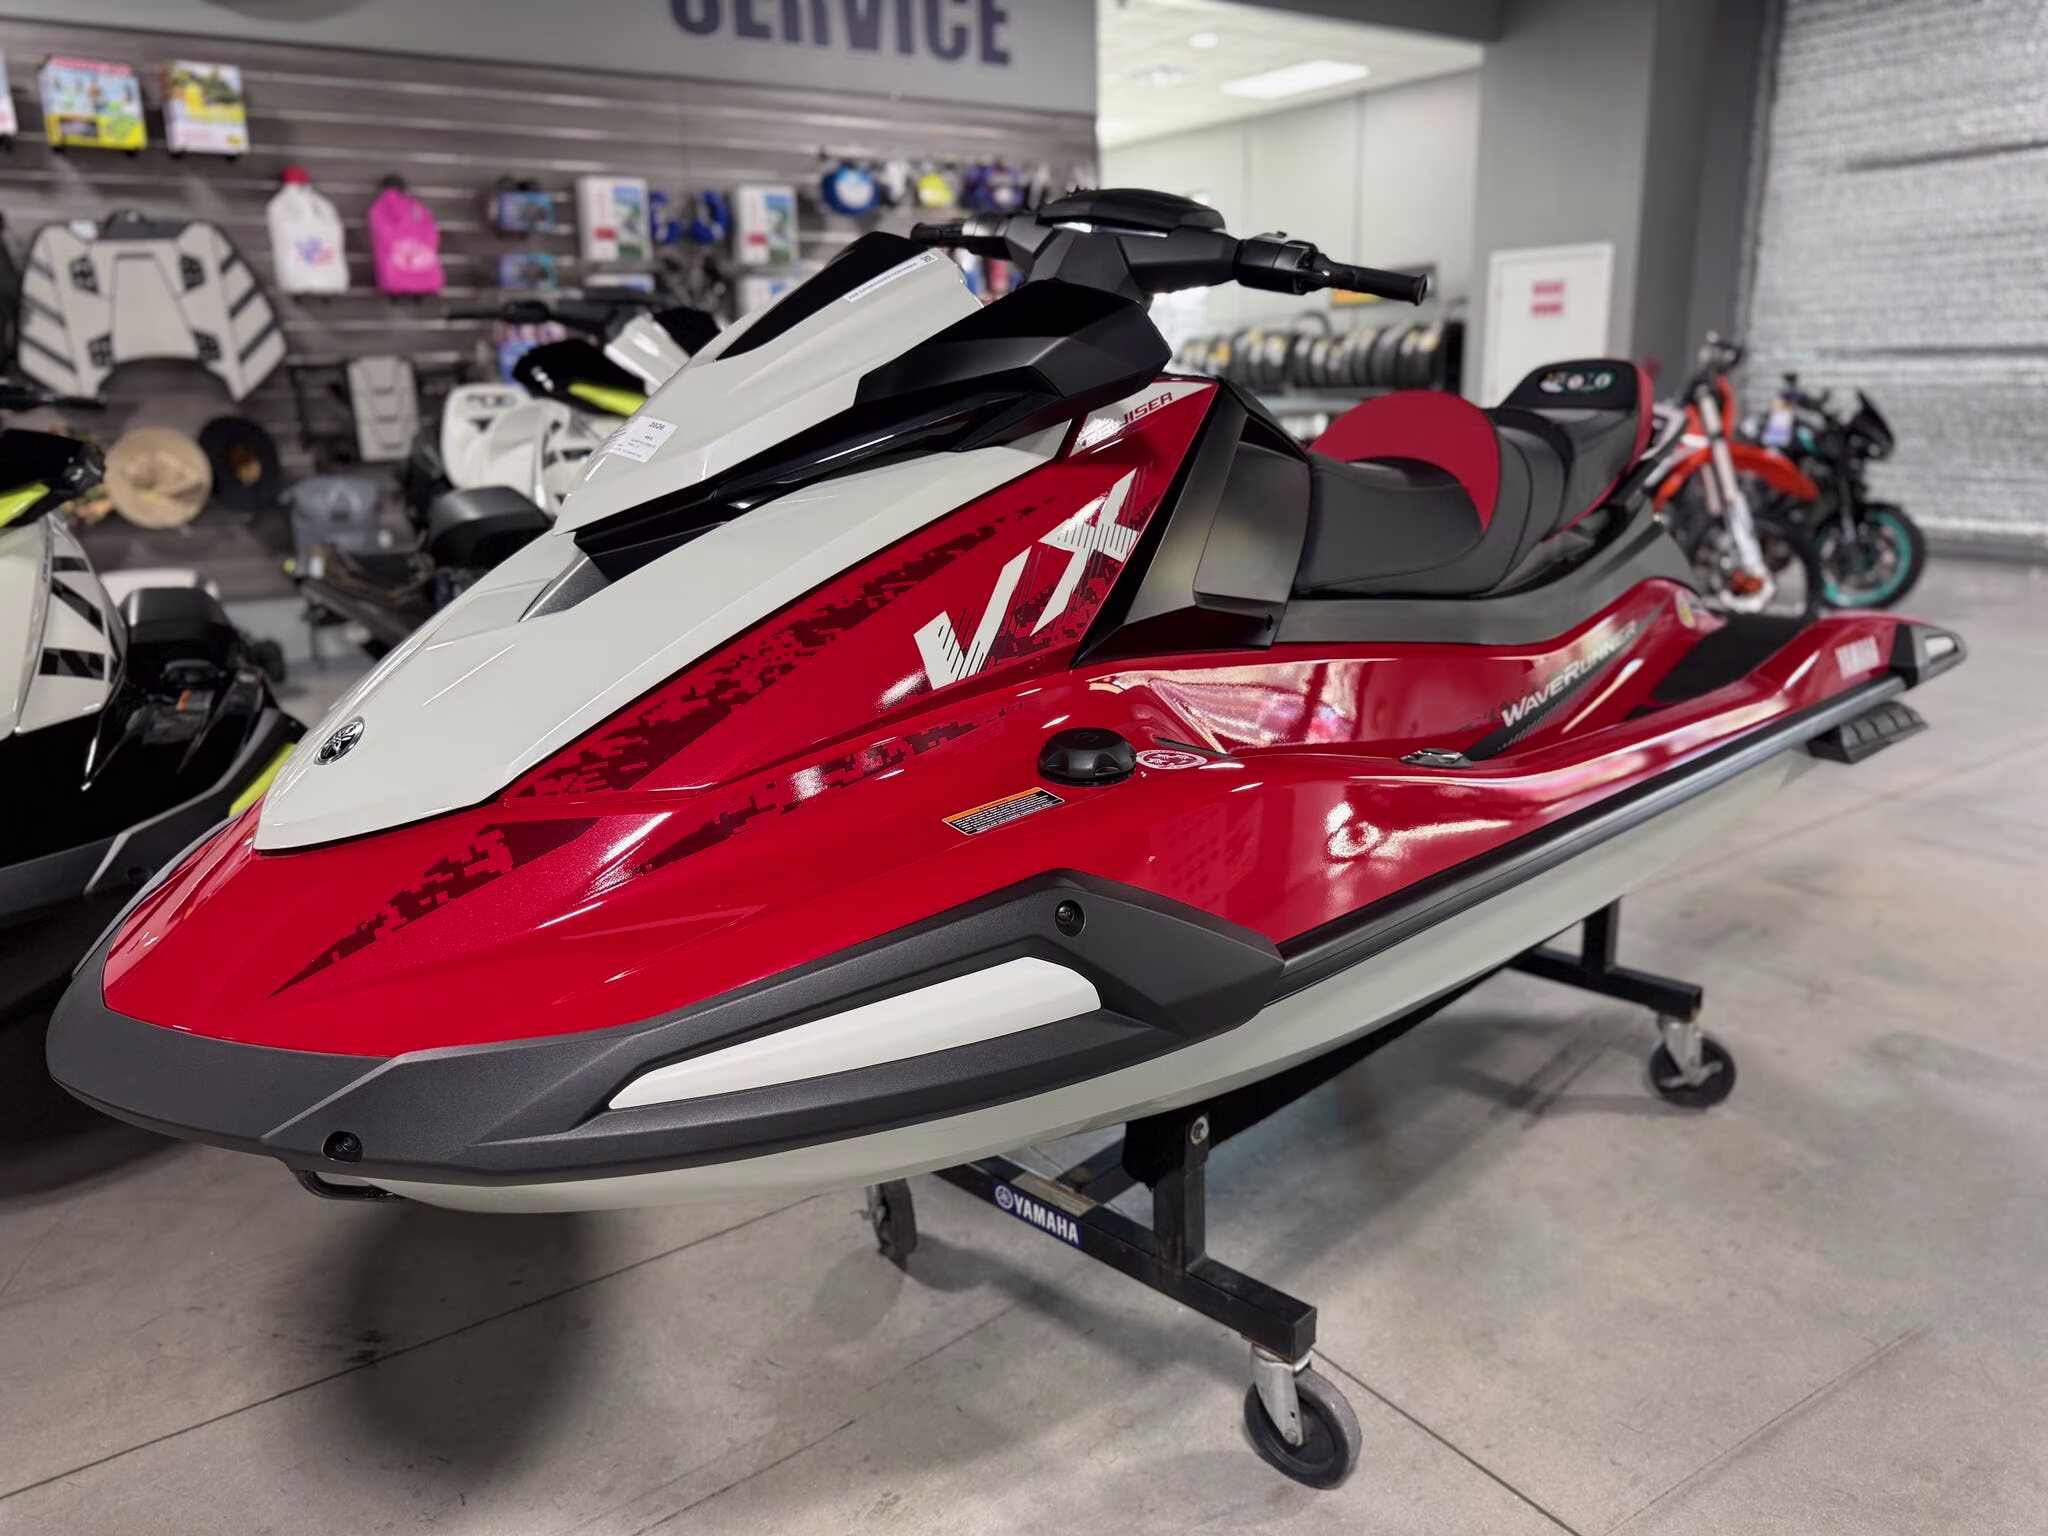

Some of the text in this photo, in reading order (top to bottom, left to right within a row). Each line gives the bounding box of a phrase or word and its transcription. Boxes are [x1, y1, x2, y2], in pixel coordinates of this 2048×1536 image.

[1080, 392, 1173, 447] UISER
[913, 467, 1139, 690] VX
[1014, 1193, 1079, 1245] YAMAHA
